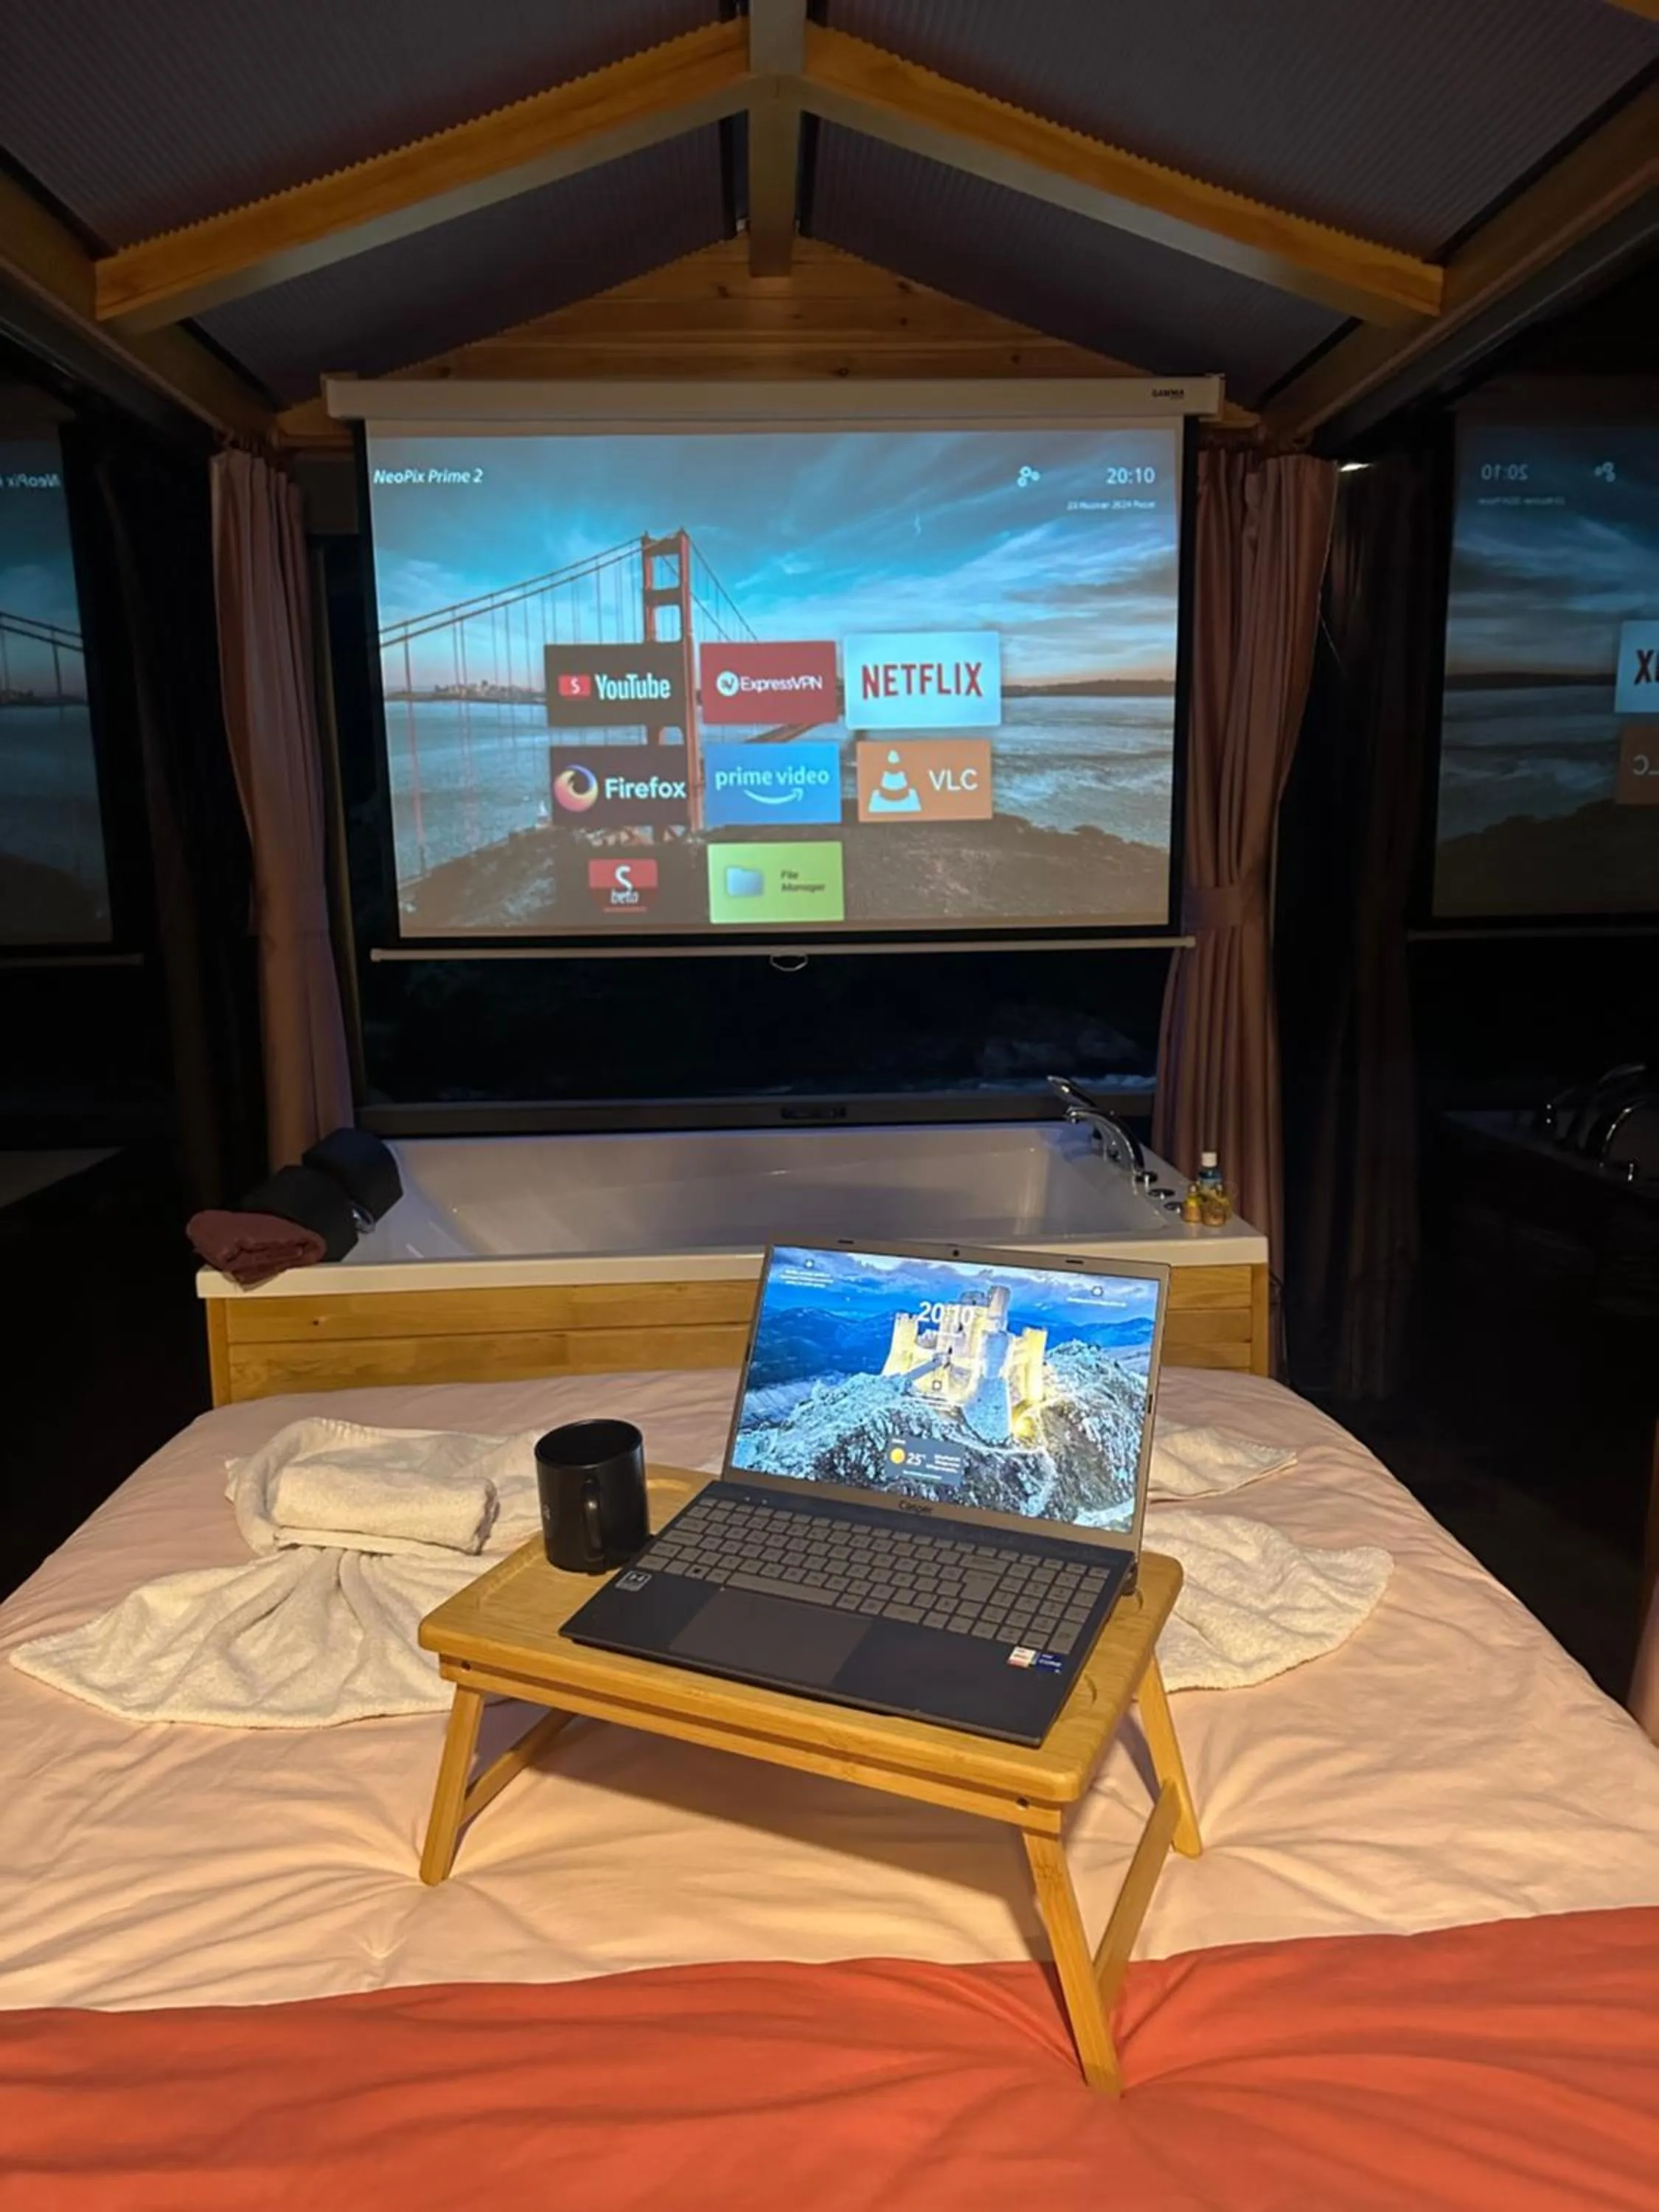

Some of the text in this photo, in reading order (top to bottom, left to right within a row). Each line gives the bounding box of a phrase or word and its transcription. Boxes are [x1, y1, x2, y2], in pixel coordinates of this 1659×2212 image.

[373, 467, 484, 484] NeoPix Prime 2
[1106, 467, 1156, 484] 20:10
[594, 672, 672, 700] YouTube
[740, 675, 823, 693] ExpressVPN
[861, 661, 983, 700] NETFLIX
[605, 776, 686, 799] Firefox
[715, 765, 830, 790] prime video
[928, 768, 978, 791] VLC
